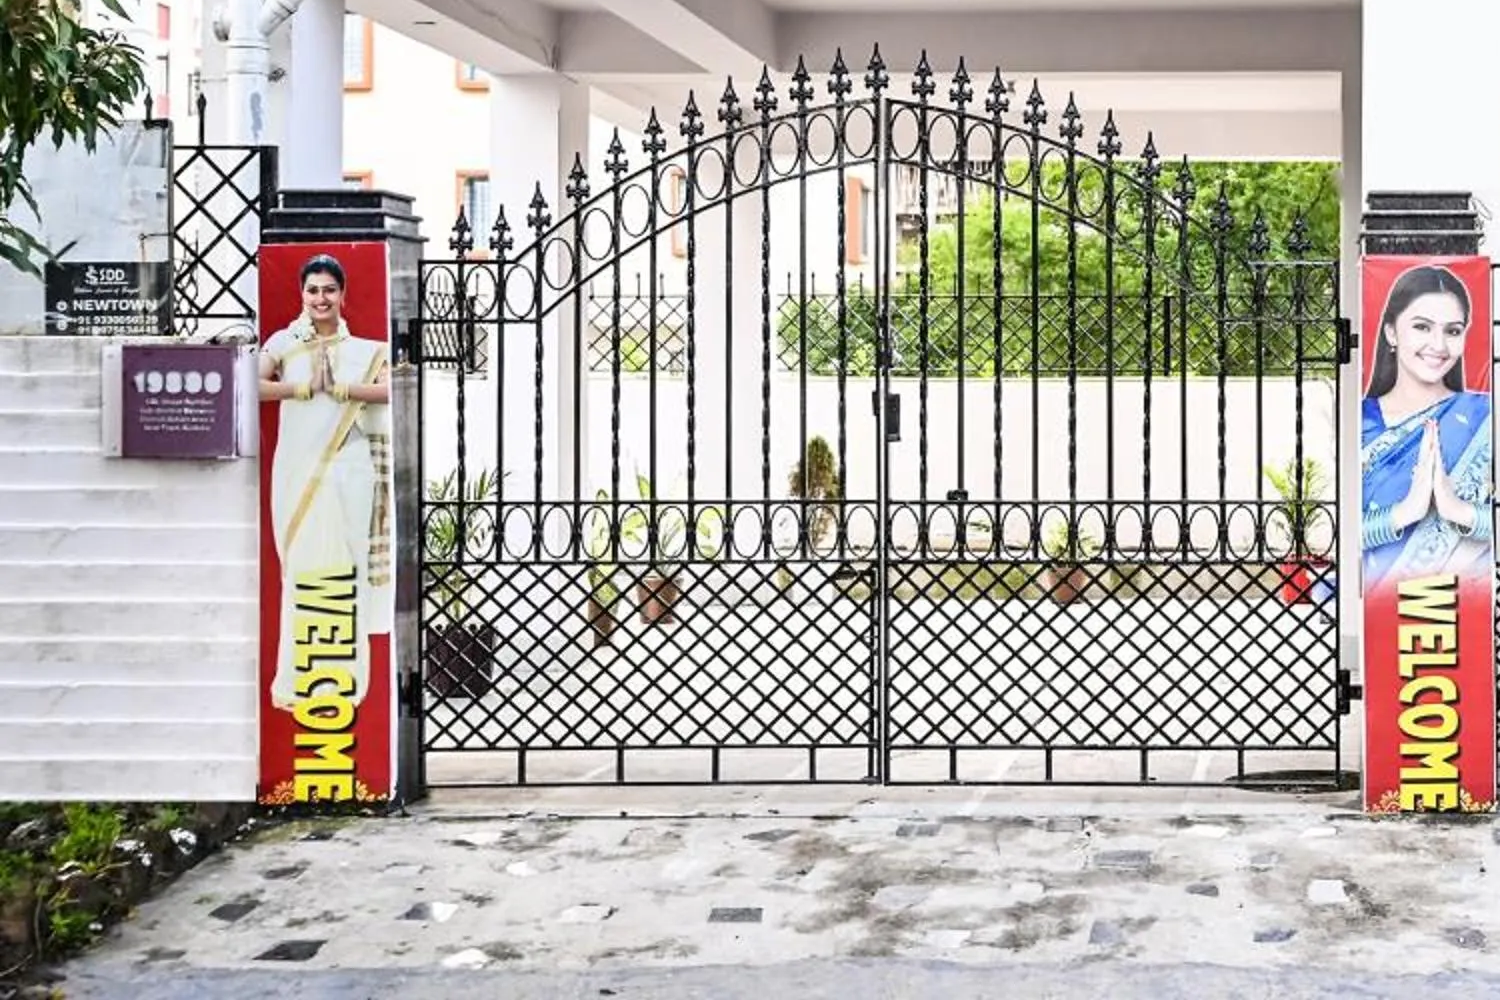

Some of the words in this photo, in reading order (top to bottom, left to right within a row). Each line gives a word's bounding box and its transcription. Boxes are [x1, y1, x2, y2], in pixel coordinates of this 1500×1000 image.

[73, 299, 158, 312] NEWTOWN
[292, 565, 357, 803] WELCOME
[1397, 573, 1460, 813] WELCOME
